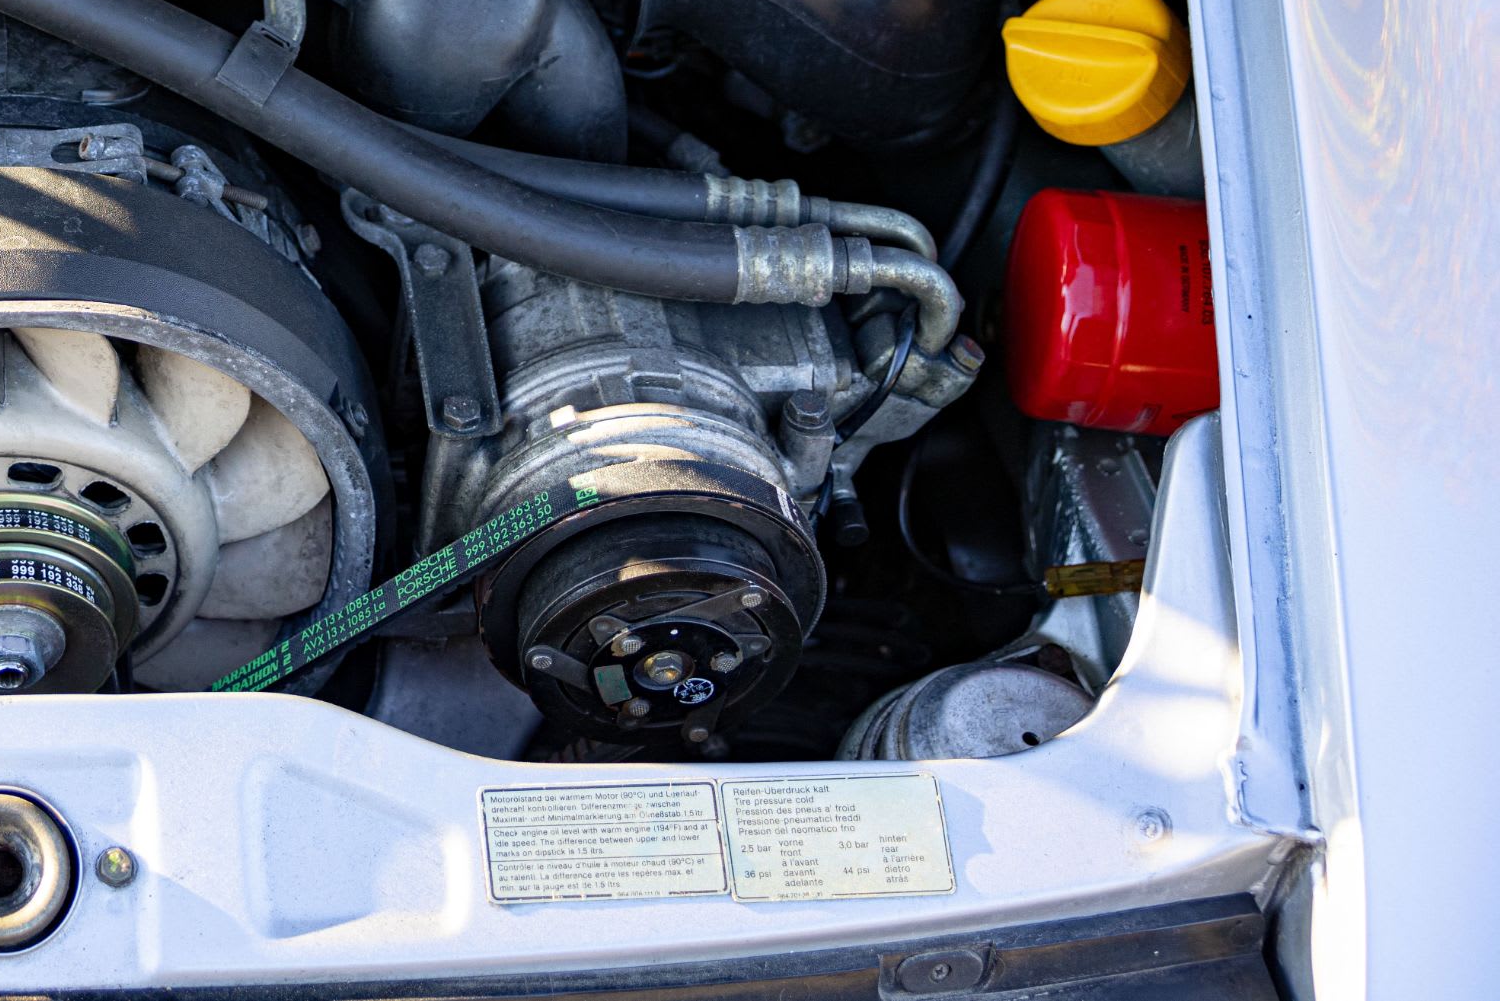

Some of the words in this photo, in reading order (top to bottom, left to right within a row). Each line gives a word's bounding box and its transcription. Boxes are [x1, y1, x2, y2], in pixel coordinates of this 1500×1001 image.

[27, 513, 49, 527] 192
[281, 640, 290, 653] 2
[301, 623, 322, 641] AVX
[324, 613, 336, 627] 13
[345, 593, 369, 616] 1085
[371, 588, 384, 600] La
[394, 547, 454, 586] PORSCHE
[462, 491, 549, 546] 999.192.363.50
[11, 565, 36, 576] 999
[40, 569, 62, 583] 192
[65, 577, 84, 595] 338
[283, 653, 292, 666] 2
[303, 636, 325, 655] AVX
[326, 626, 338, 640] 13
[347, 607, 371, 628] 1085
[373, 600, 386, 614] La
[397, 558, 457, 599] PORSCHE
[465, 504, 552, 559] 999.192.363.50
[813, 785, 830, 793] kalt
[595, 791, 618, 800] Motor
[649, 790, 663, 798] und
[734, 797, 750, 805] Tire
[754, 797, 792, 807] pressure
[795, 795, 814, 803] cold
[735, 807, 773, 816] Pression
[776, 806, 792, 814] des
[795, 806, 822, 816] pneus
[835, 804, 856, 812] froid
[835, 813, 861, 822] freddi
[493, 829, 518, 837] Check
[521, 829, 548, 838] engine
[550, 827, 560, 835] oil
[561, 826, 580, 834] level
[582, 826, 598, 834] with
[600, 825, 622, 833] warm
[625, 825, 651, 834] engine
[684, 823, 698, 831] and
[738, 827, 772, 836] Presion
[775, 827, 788, 835] del
[791, 825, 838, 834] neomatico
[840, 824, 856, 832] frio
[557, 837, 597, 845] difference
[599, 836, 634, 844] between
[636, 836, 658, 845] upper
[757, 844, 771, 852] bar
[778, 839, 804, 847] vorne
[855, 840, 869, 848] bar
[879, 834, 907, 843] hinten
[495, 849, 520, 857] marks
[534, 848, 565, 857] dipstick
[780, 848, 802, 857] front
[881, 845, 899, 853] rear
[790, 857, 819, 866] l'avant
[891, 853, 925, 862] l'arrière
[546, 862, 573, 870] niveau
[611, 859, 639, 867] moteur
[641, 858, 666, 867] chaud
[540, 872, 550, 880] La
[618, 869, 629, 877] les
[744, 870, 756, 879] 36
[758, 870, 772, 879] psi
[783, 868, 816, 877] davanti
[842, 866, 853, 875] 44
[857, 866, 870, 876] psi
[884, 864, 911, 873] dietro
[784, 877, 824, 887] adelante
[886, 875, 909, 884] atrás
[542, 883, 565, 893] jauge
